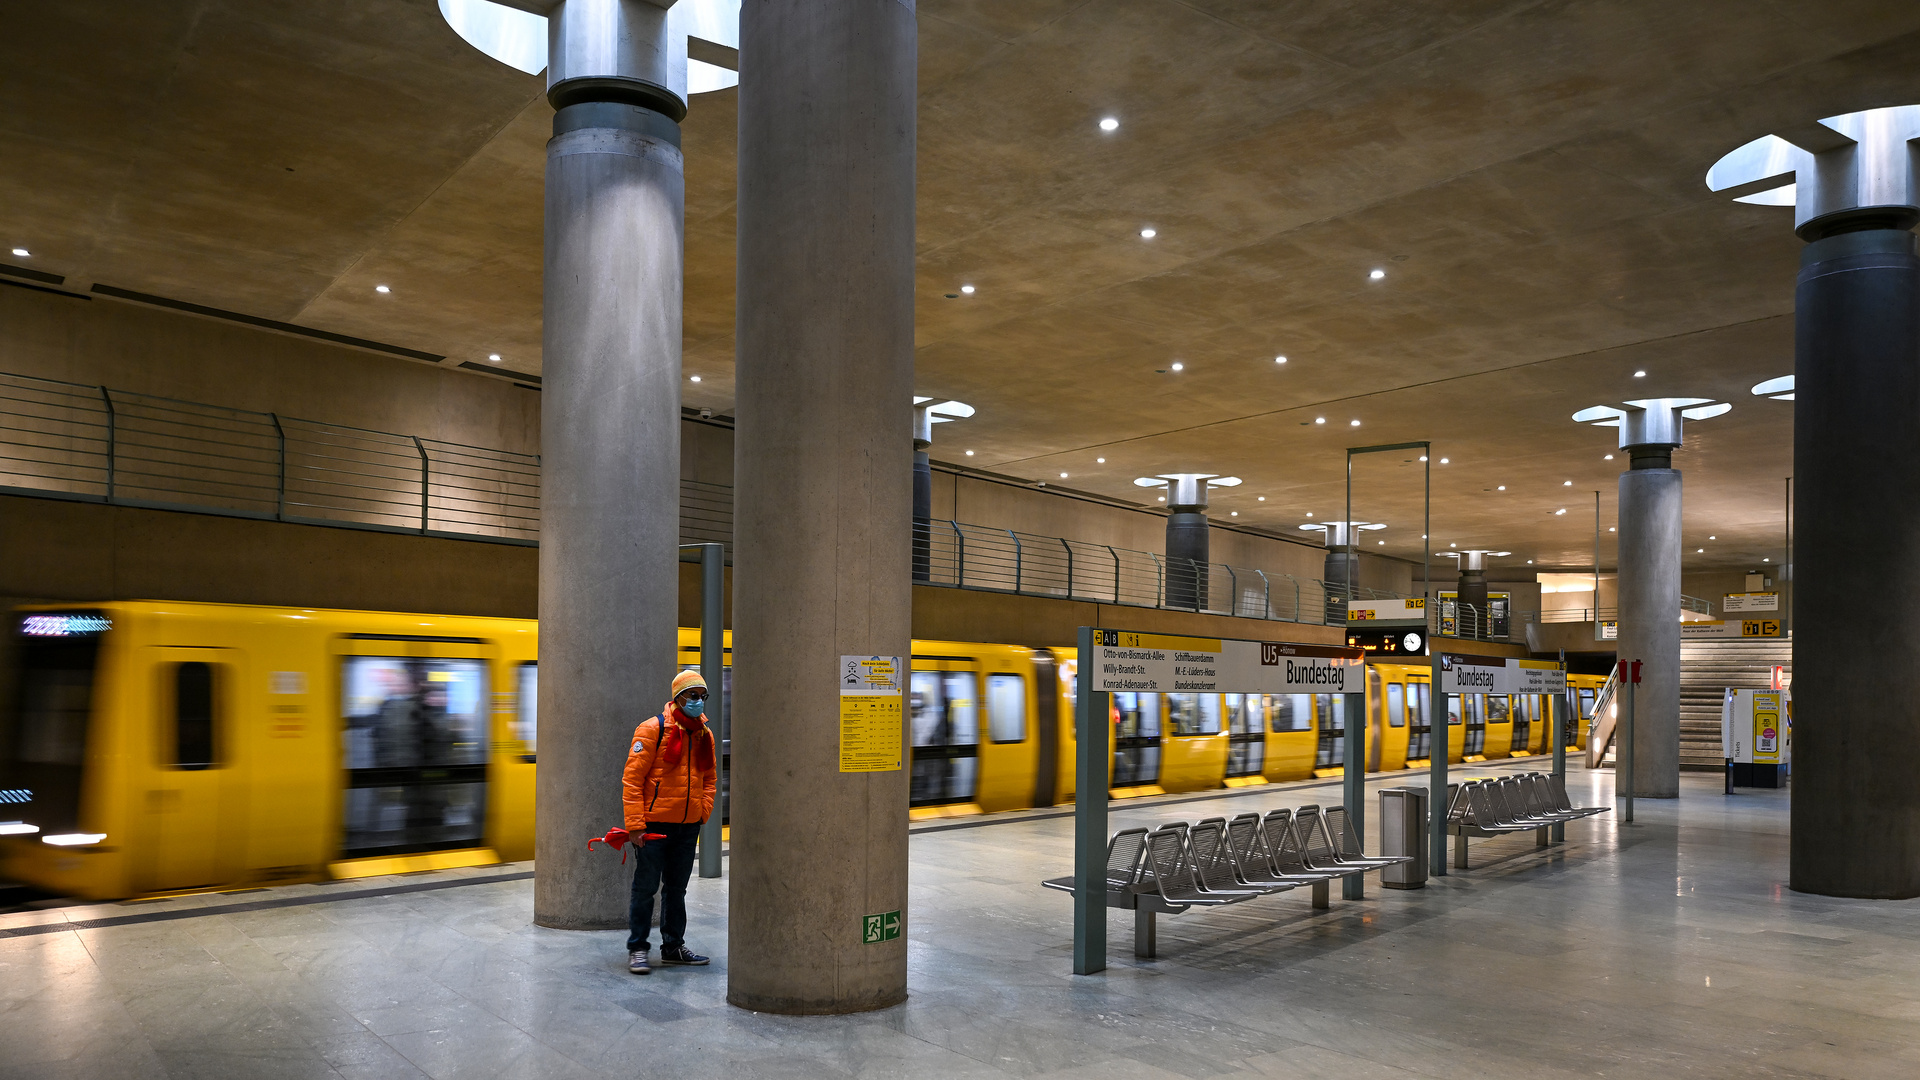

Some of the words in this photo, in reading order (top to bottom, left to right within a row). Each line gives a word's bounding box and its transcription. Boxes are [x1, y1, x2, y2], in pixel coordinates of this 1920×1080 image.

[1104, 634, 1109, 642] A
[1112, 634, 1116, 644] B
[1104, 649, 1165, 660] Otto-von-Bismarck-Allee
[1174, 652, 1214, 662] Schiffbauerdamm
[1263, 645, 1277, 664] U5
[1442, 656, 1452, 670] U5
[1104, 664, 1146, 676] Willy-Brandt-Str.
[1175, 667, 1216, 676] M.-E.-Lüders-Haus
[1286, 660, 1344, 690] Bundestag
[1104, 679, 1158, 690] Konrad-Adenauer-Str.
[1458, 667, 1494, 692] Bundestag
[1174, 681, 1216, 690] Bundeskanzleramt
